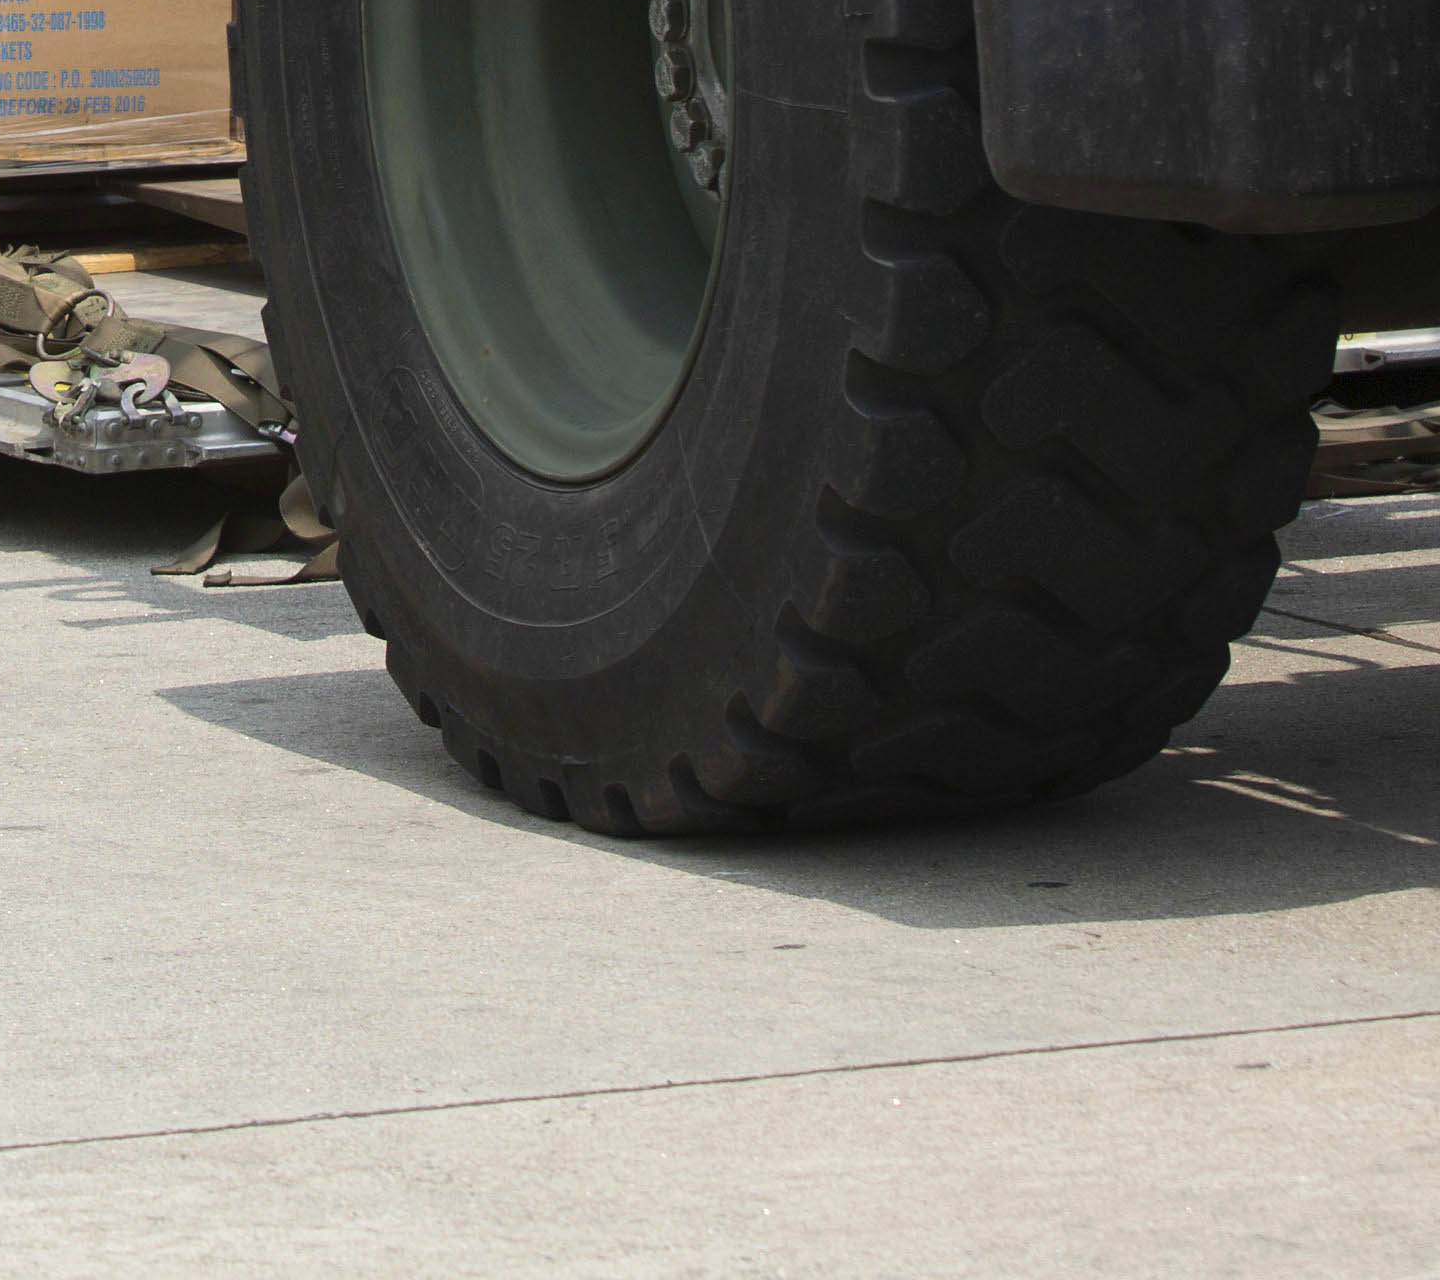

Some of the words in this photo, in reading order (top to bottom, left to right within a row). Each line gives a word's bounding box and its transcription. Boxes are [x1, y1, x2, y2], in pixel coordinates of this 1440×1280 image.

[13, 70, 48, 90] CODE
[81, 95, 110, 114] FEB
[112, 95, 145, 113] 2016
